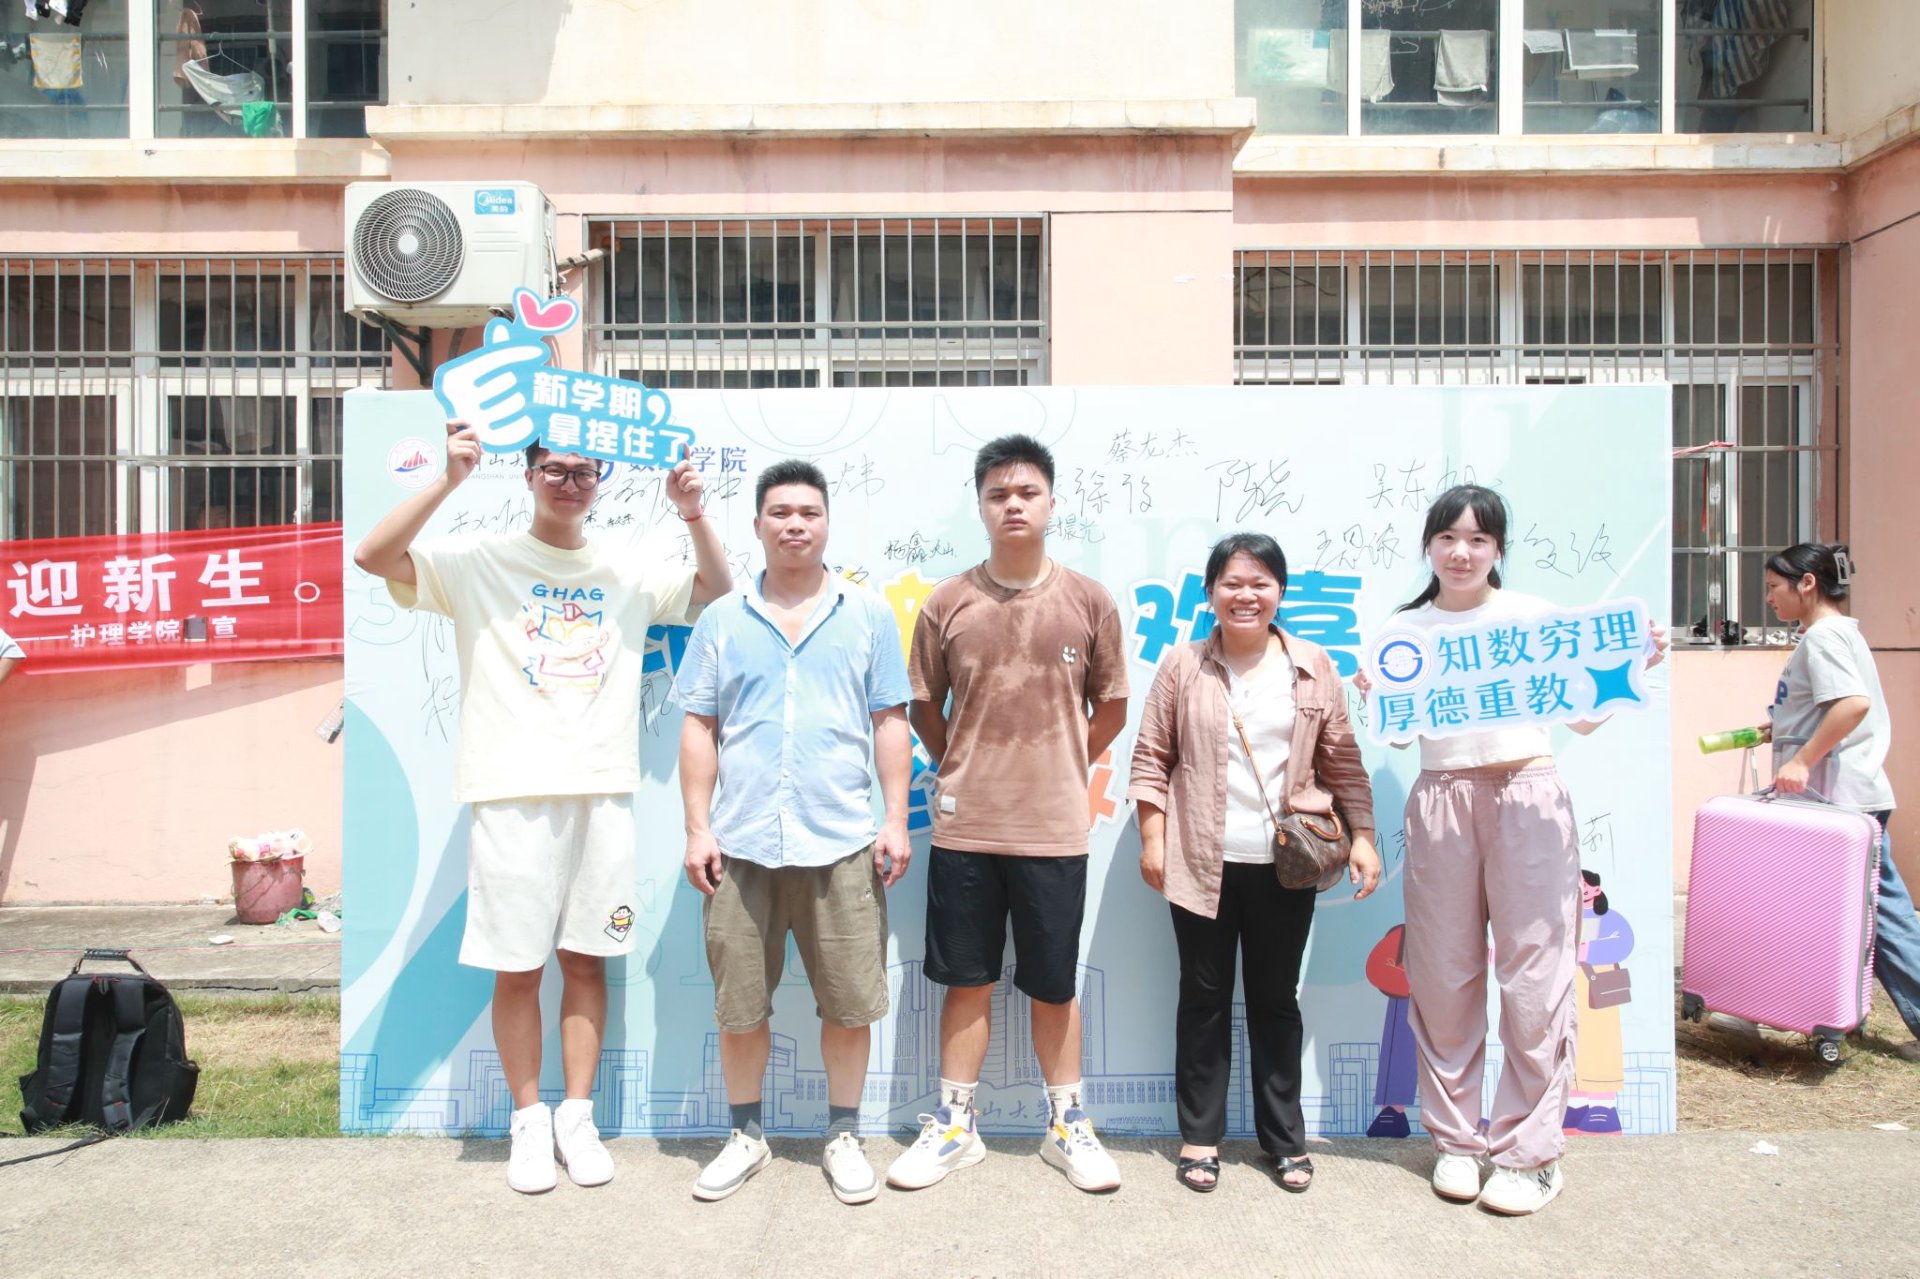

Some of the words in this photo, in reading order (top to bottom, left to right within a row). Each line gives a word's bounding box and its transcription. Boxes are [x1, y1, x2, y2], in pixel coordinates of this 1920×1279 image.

[547, 412, 690, 464] 拿捏住了
[531, 583, 606, 601] GHAG
[1437, 610, 1642, 676] 知数穷理
[1378, 672, 1574, 734] 厚德重教
